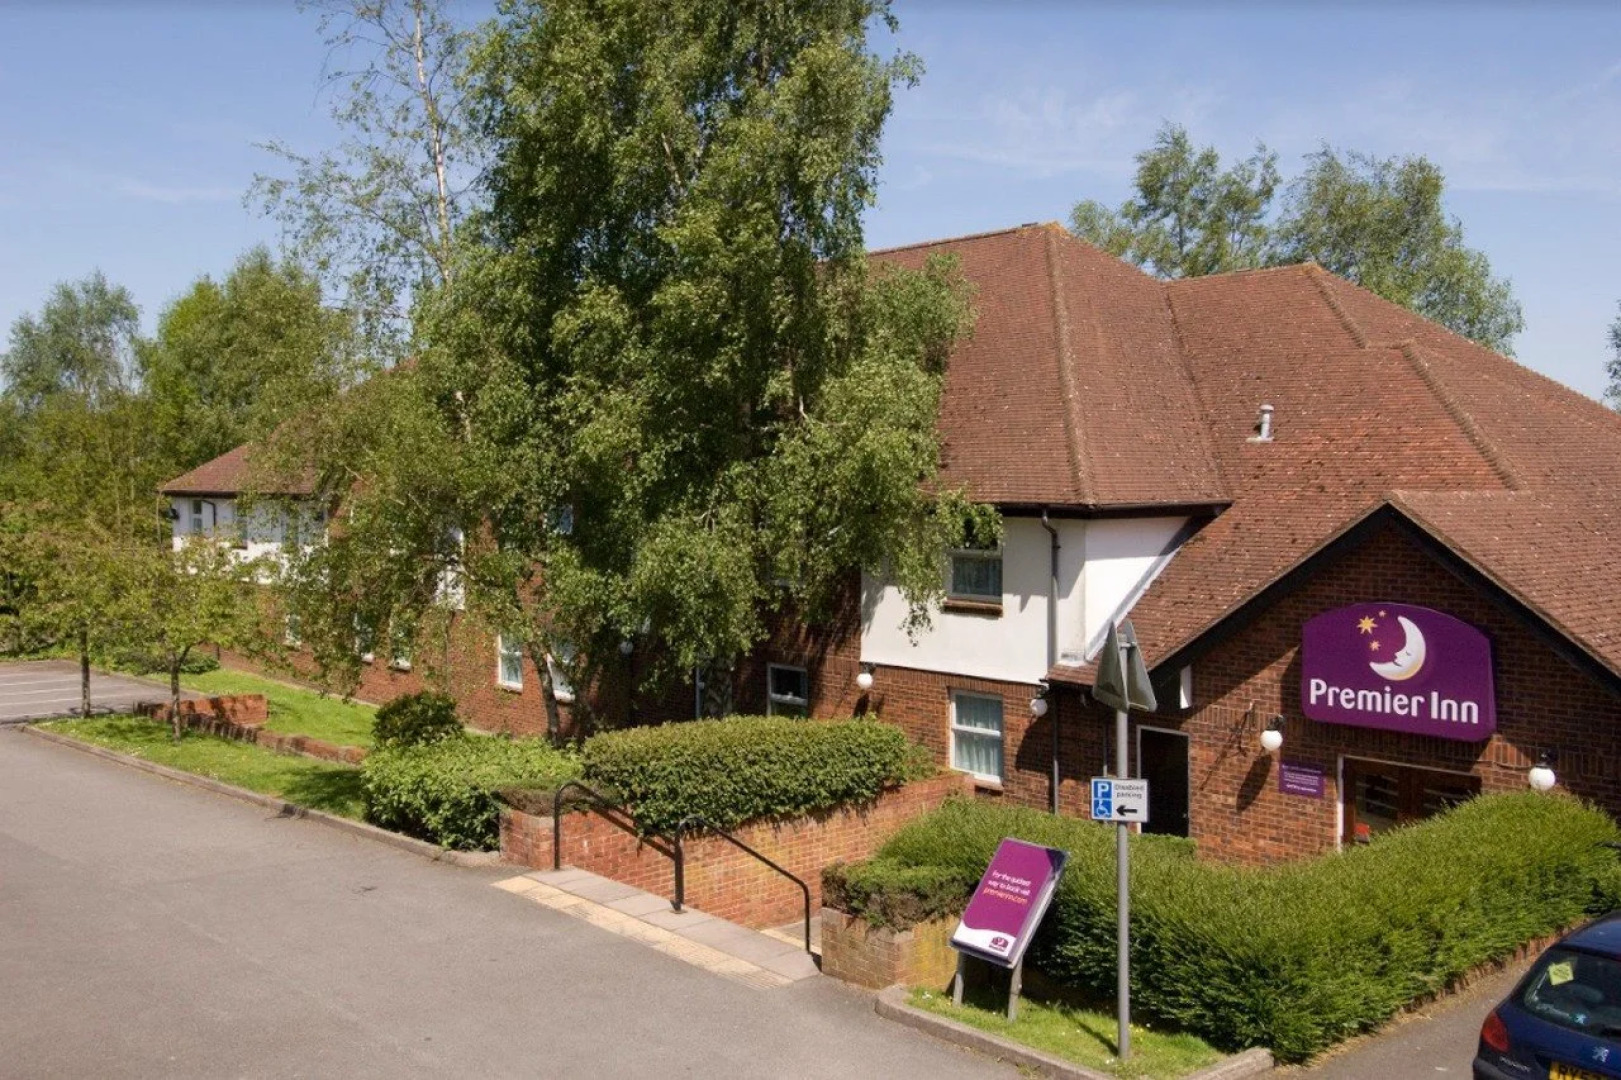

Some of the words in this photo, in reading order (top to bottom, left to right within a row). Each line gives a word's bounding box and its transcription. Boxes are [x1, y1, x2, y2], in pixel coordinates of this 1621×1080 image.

[1309, 678, 1425, 717] Premier
[1431, 691, 1479, 724] Inn
[1097, 783, 1109, 798] P
